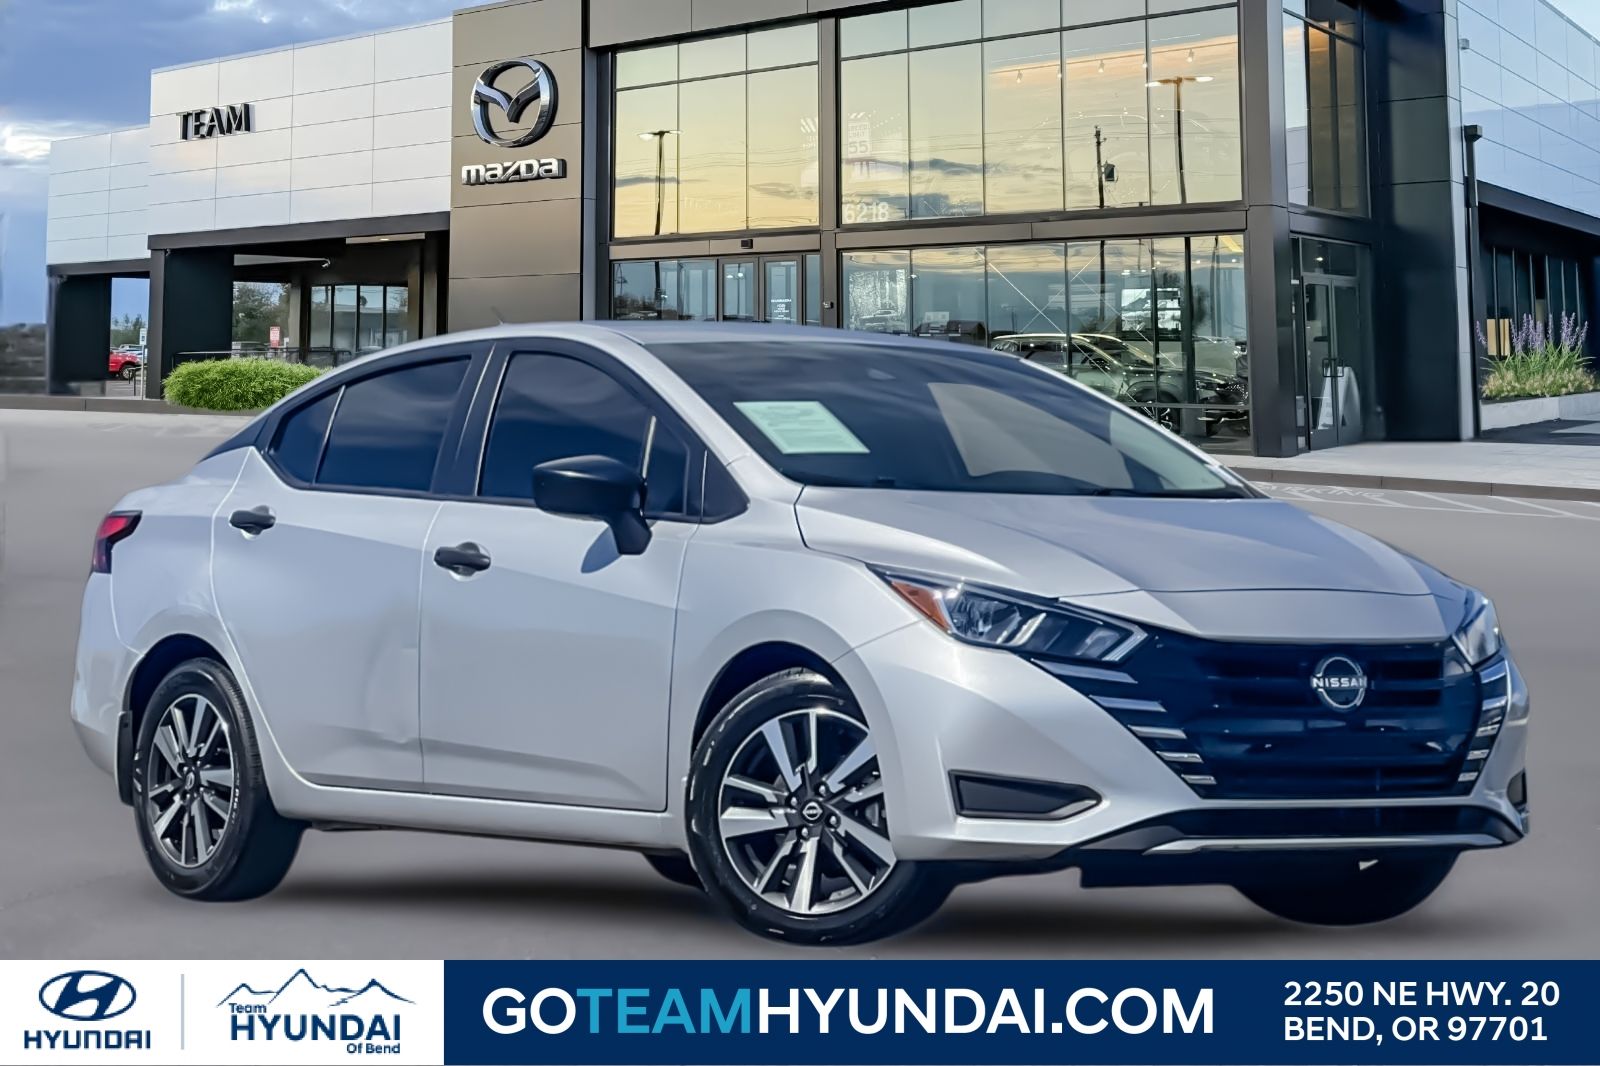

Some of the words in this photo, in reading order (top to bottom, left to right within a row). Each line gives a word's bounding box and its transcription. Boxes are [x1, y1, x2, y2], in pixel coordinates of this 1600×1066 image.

[176, 103, 251, 141] TEAM
[461, 158, 567, 186] mazda
[844, 201, 889, 223] 6218
[1311, 677, 1368, 688] NISSAN
